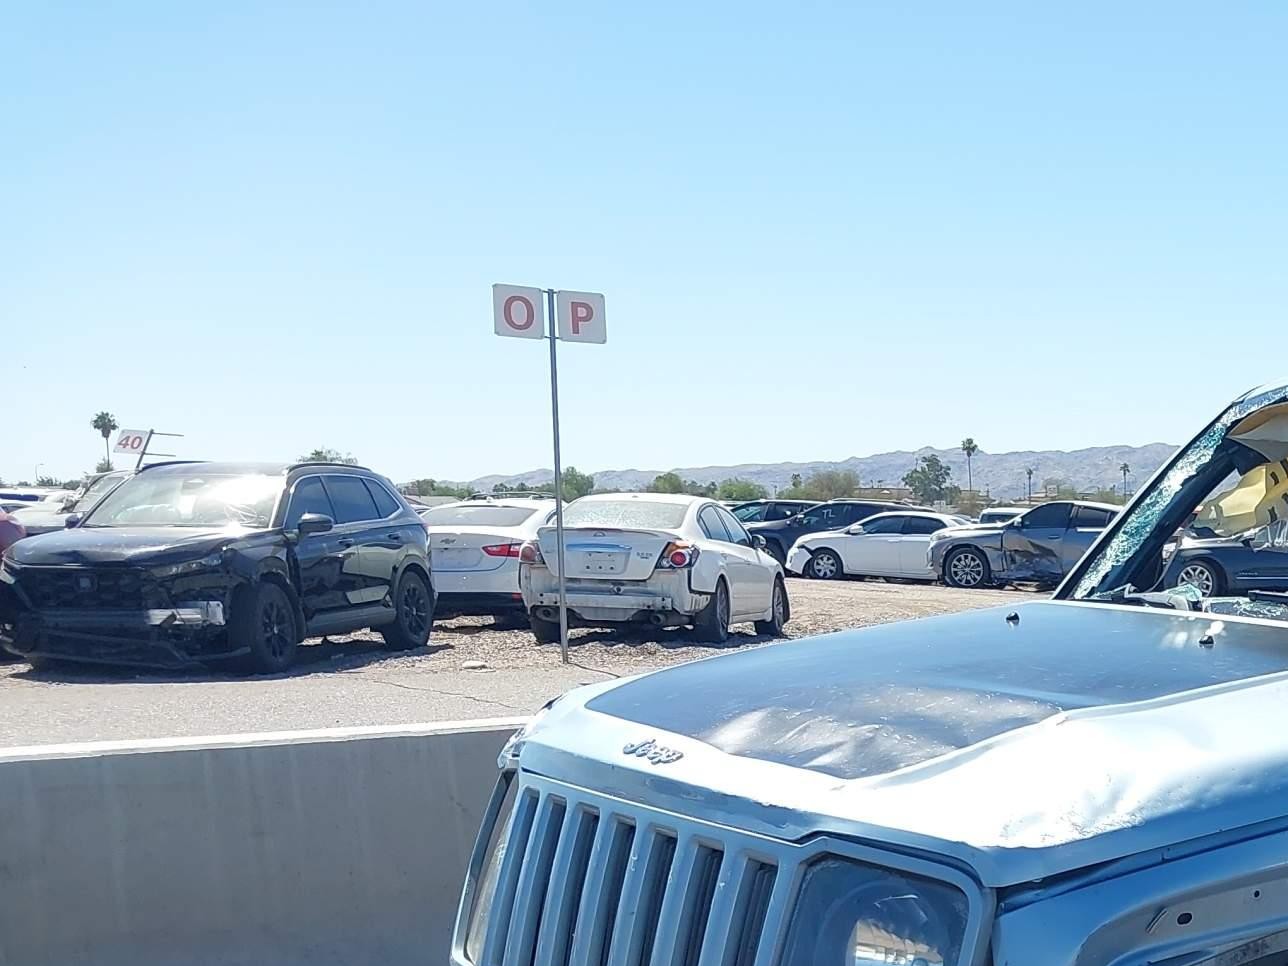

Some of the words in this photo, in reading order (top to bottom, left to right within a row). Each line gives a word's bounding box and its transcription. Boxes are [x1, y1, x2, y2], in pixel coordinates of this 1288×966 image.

[504, 295, 534, 331] O
[570, 301, 594, 334] P
[117, 435, 143, 450] 40
[623, 739, 684, 765] Jeep
